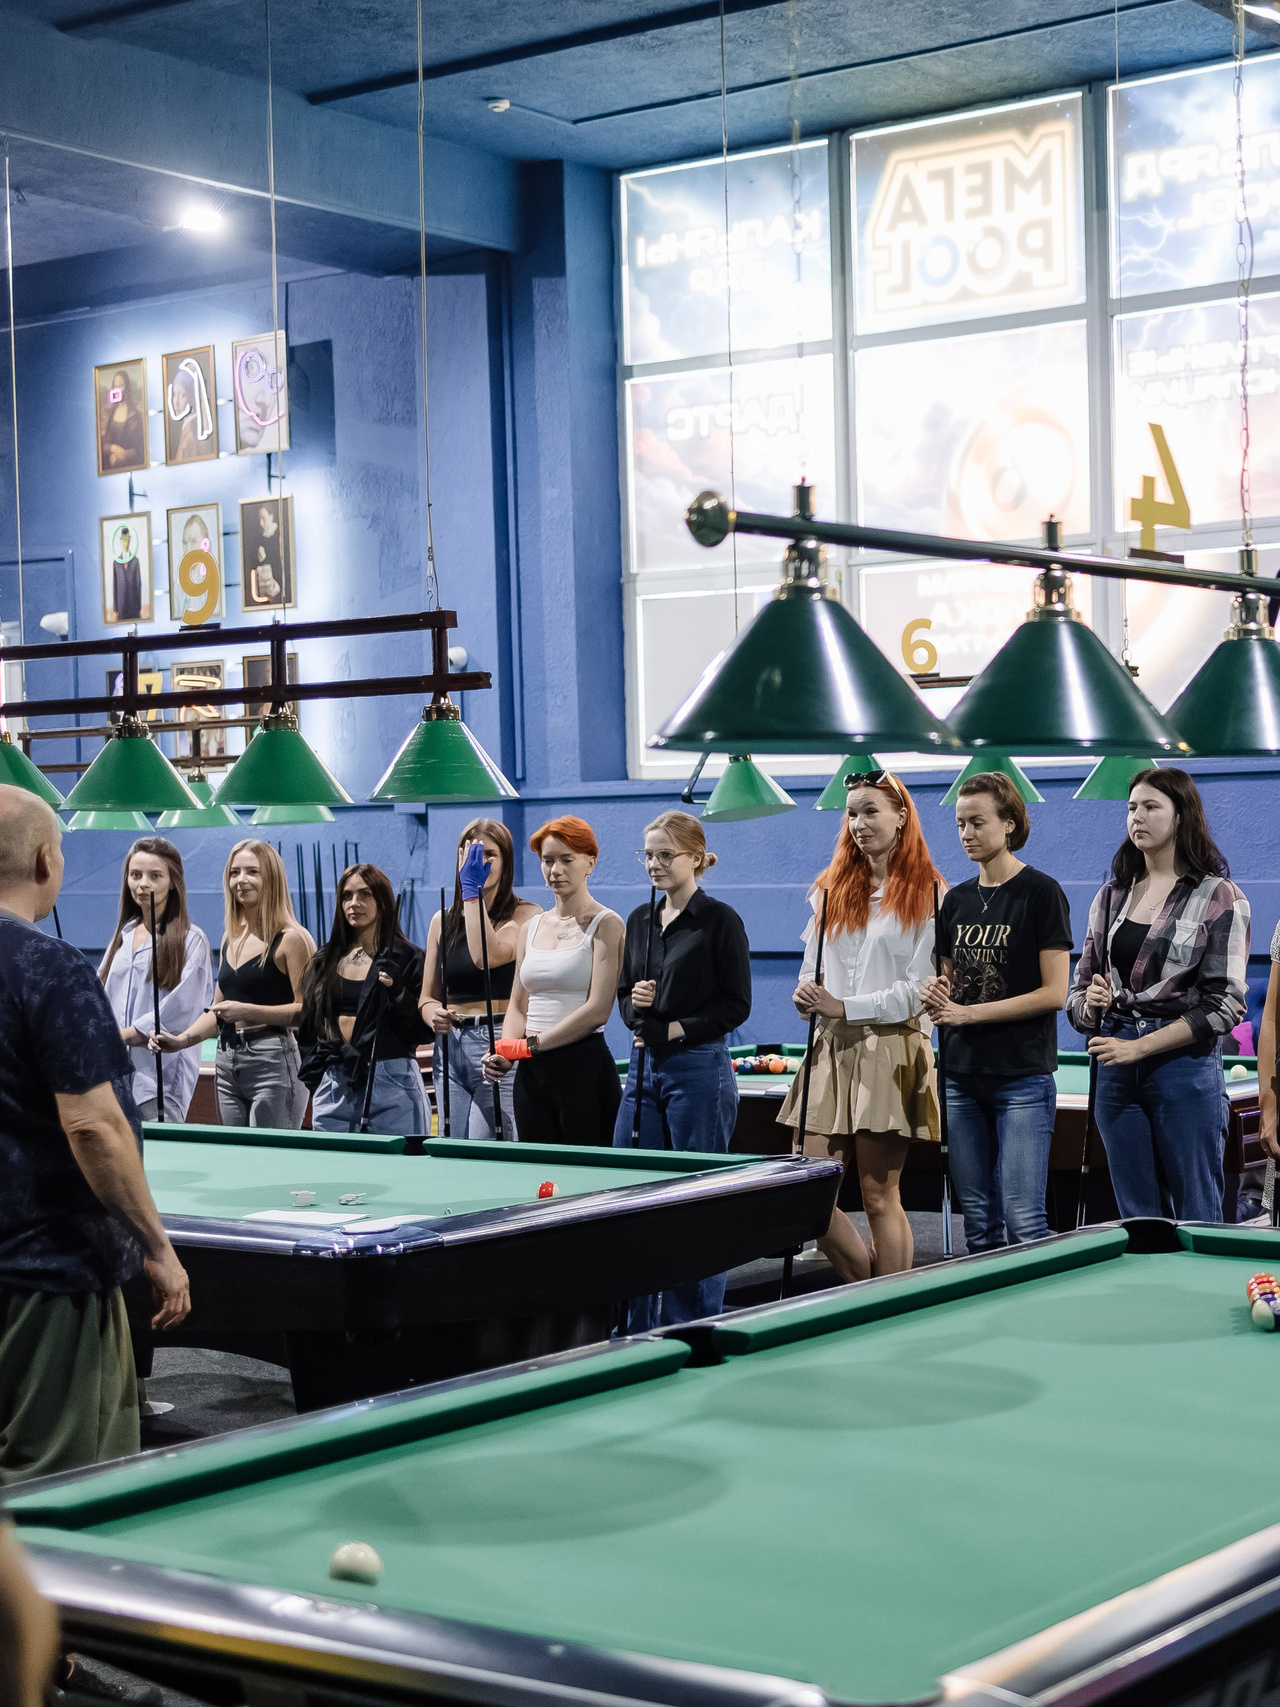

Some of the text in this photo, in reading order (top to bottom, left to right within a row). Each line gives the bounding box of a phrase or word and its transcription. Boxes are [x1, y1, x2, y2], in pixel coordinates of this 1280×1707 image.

[179, 549, 219, 626] 9
[902, 617, 938, 673] 6
[955, 923, 1011, 948] YOUR
